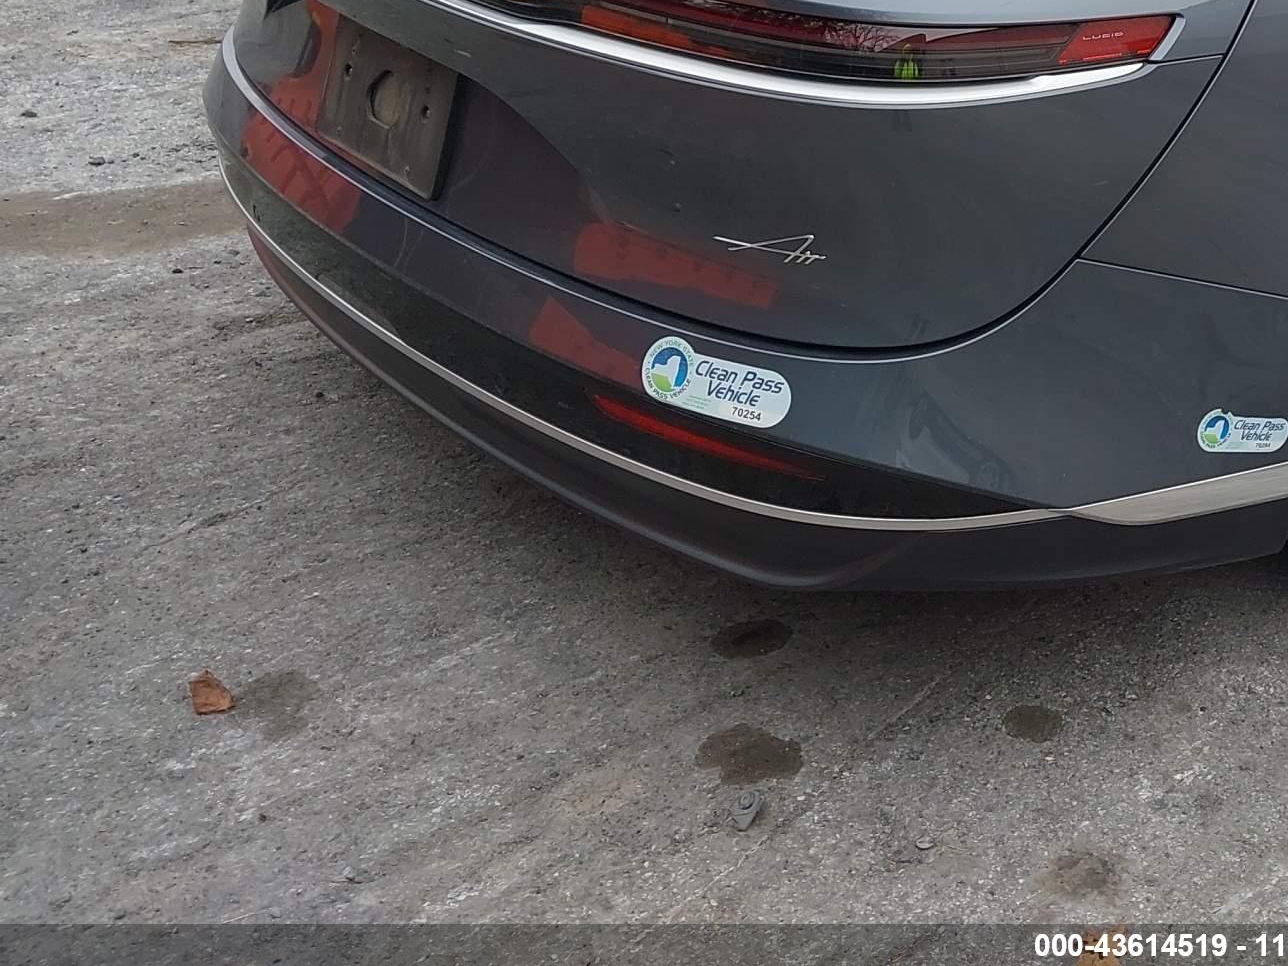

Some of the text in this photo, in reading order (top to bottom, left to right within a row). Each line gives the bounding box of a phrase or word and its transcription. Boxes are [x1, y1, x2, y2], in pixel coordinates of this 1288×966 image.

[1082, 31, 1124, 40] LUCID
[695, 360, 785, 394] Clean Pass
[707, 380, 760, 407] Vehicle
[732, 406, 762, 421] 70254
[1234, 420, 1286, 431] Clean Pass
[1240, 431, 1272, 441] Vehicle
